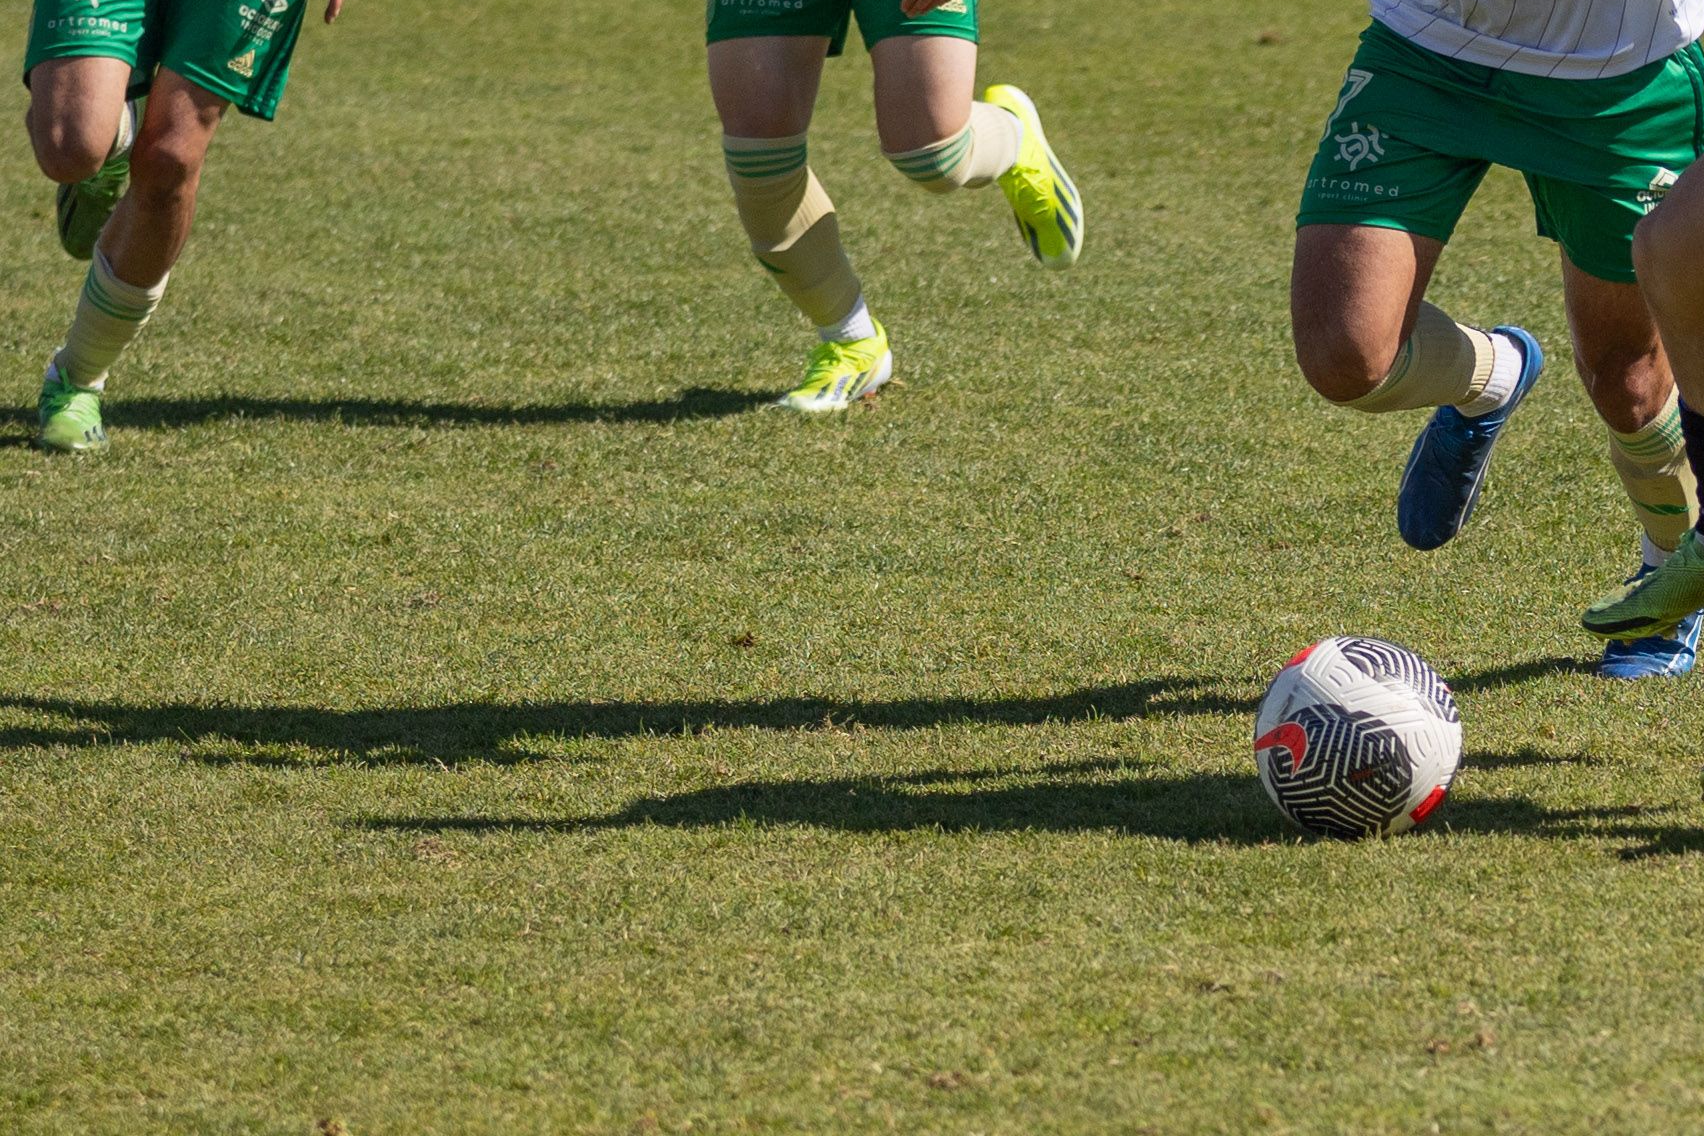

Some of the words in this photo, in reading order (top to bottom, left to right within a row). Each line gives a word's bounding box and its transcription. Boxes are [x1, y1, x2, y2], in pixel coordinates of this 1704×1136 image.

[47, 16, 128, 33] artromed
[1320, 68, 1374, 143] 7
[1318, 192, 1339, 200] sport
